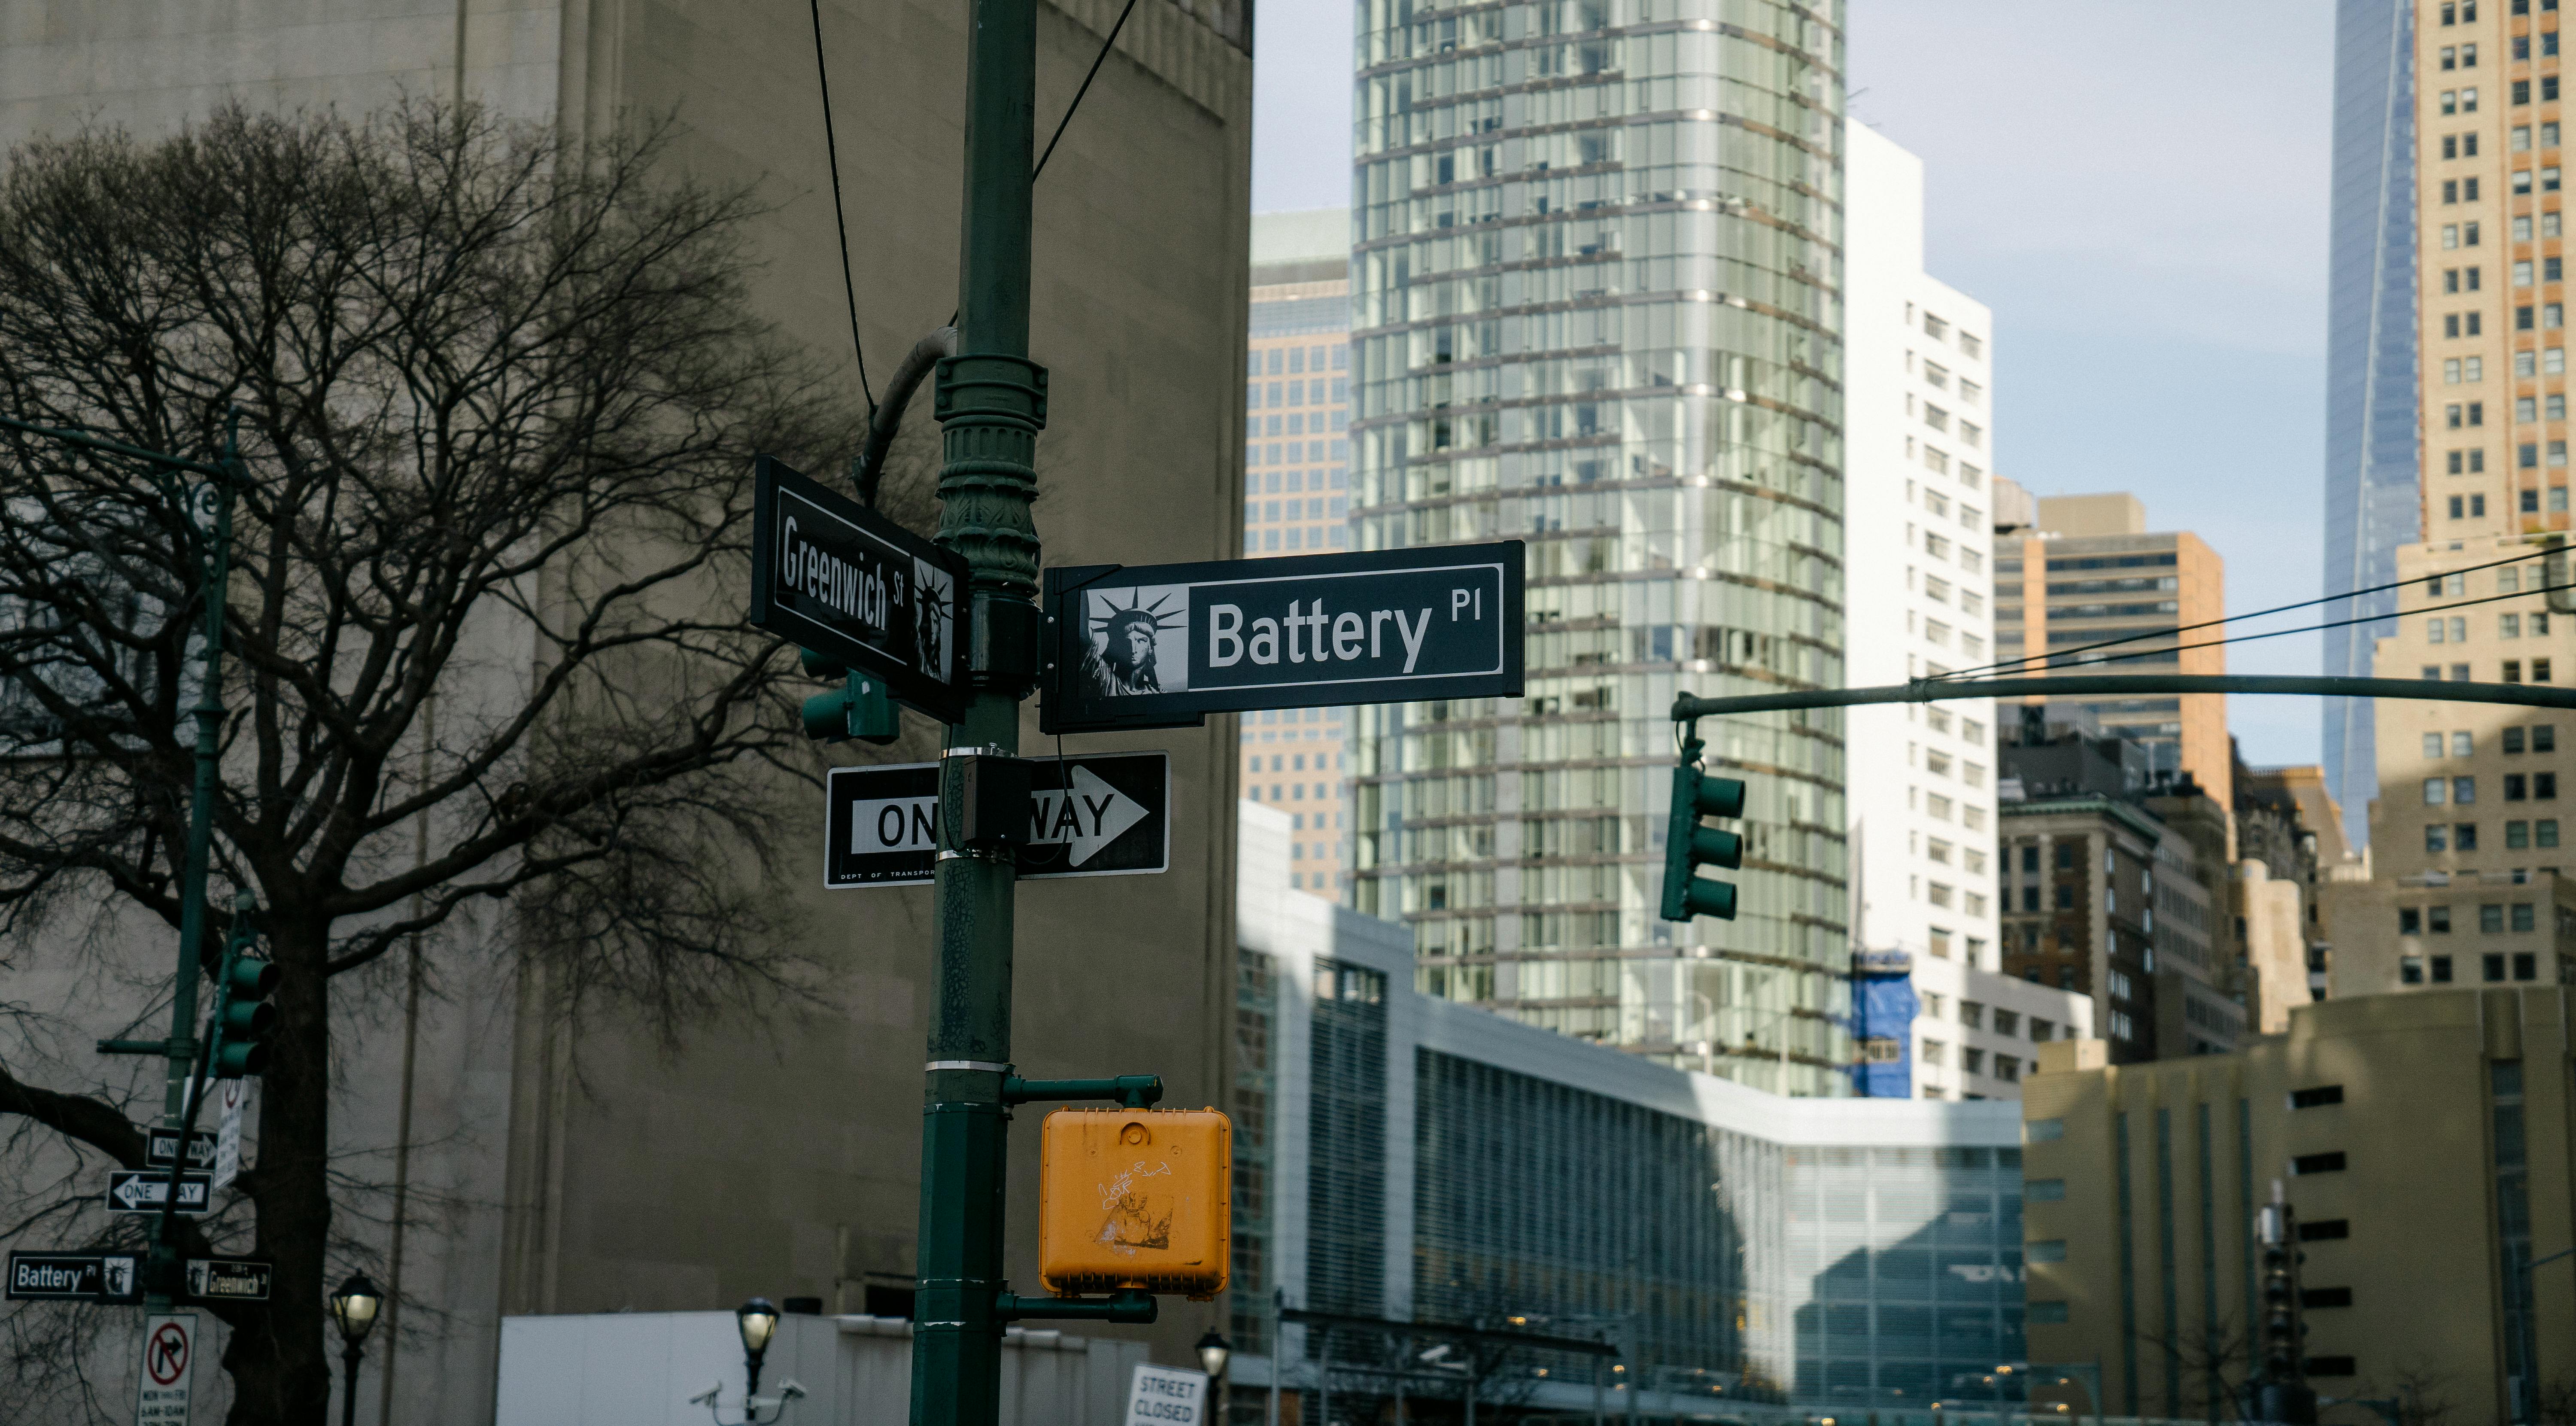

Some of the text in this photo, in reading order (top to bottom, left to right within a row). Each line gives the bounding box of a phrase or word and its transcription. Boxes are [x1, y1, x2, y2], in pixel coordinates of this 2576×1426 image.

[784, 515, 904, 631] Greenwich St
[1209, 587, 1480, 674] Battery Pl
[878, 802, 939, 847] ON
[159, 1139, 175, 1154] ON
[125, 1184, 197, 1200] ONE AY
[17, 1265, 82, 1292] Battery
[210, 1271, 258, 1294] Greenwich
[1140, 1376, 1195, 1399] STREET
[1134, 1399, 1193, 1423] CLOSED
